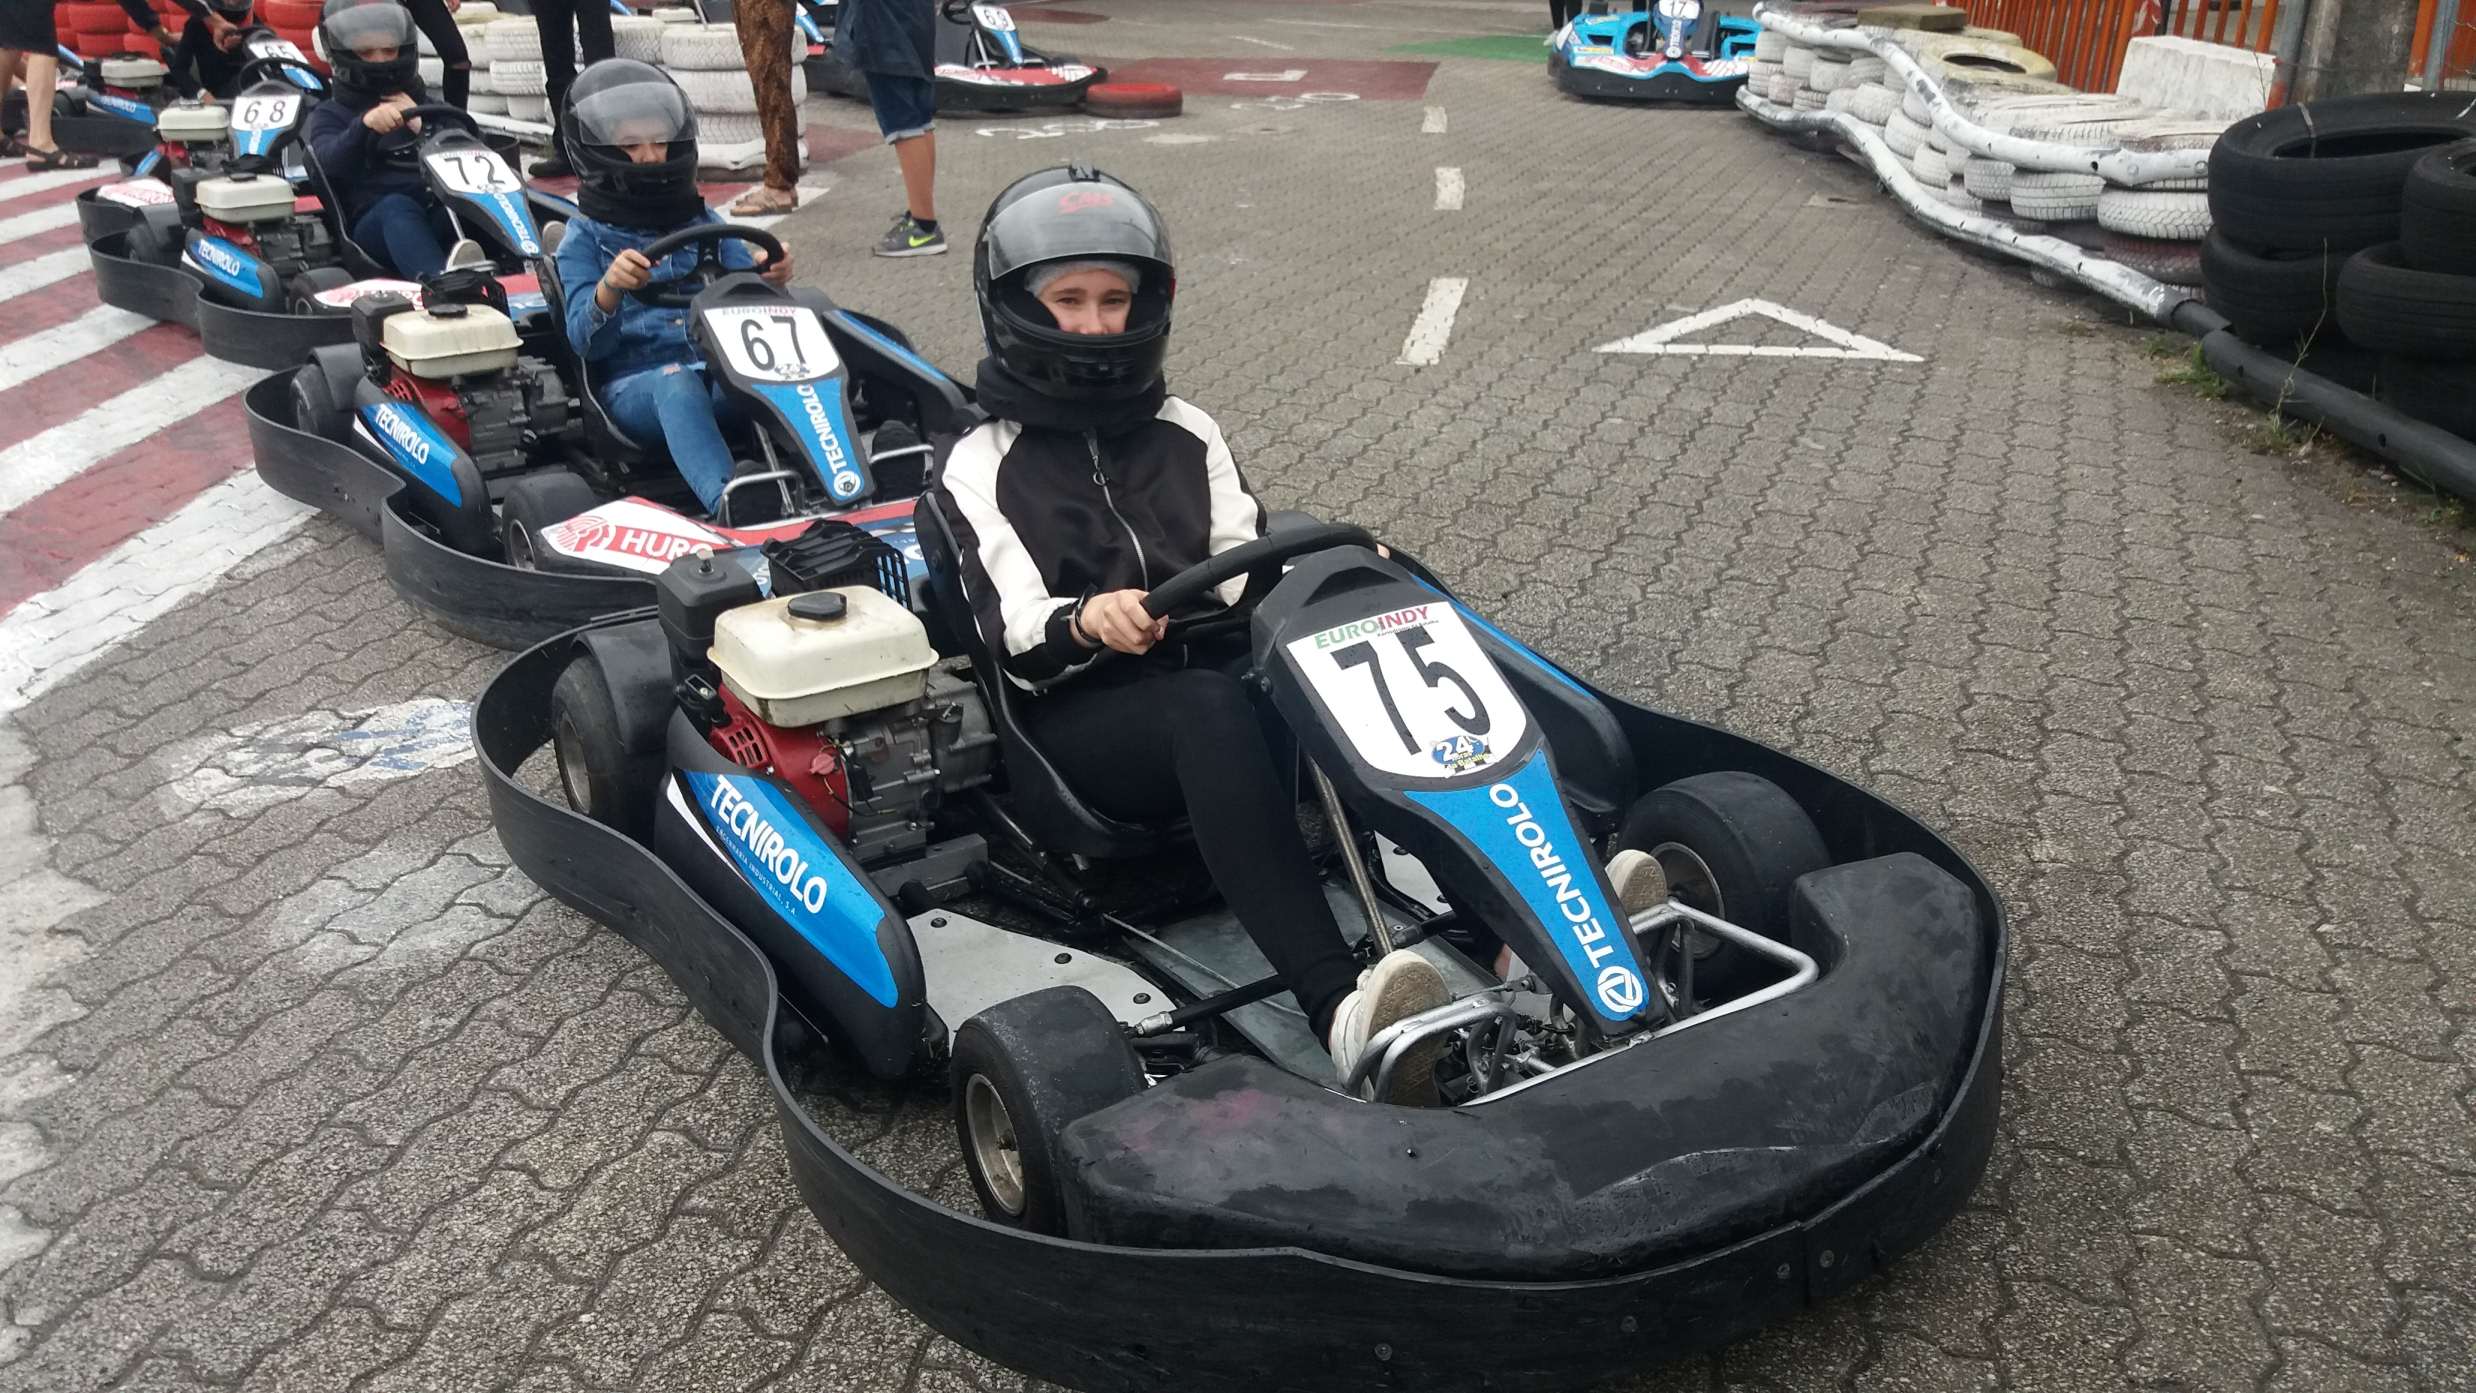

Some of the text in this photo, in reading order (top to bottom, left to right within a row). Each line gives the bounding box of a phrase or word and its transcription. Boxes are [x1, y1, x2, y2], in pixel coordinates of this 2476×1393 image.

[244, 100, 286, 124] 68
[444, 156, 505, 185] 72
[741, 315, 806, 371] 67
[375, 403, 430, 464] TECNIROLO
[797, 384, 848, 475] TECNIROLO
[1314, 606, 1429, 649] EUROINDY
[1330, 625, 1491, 756] 75
[1436, 736, 1473, 761] 24
[711, 774, 827, 913] TECNIROLO
[1489, 783, 1615, 968] TECNIROLO
